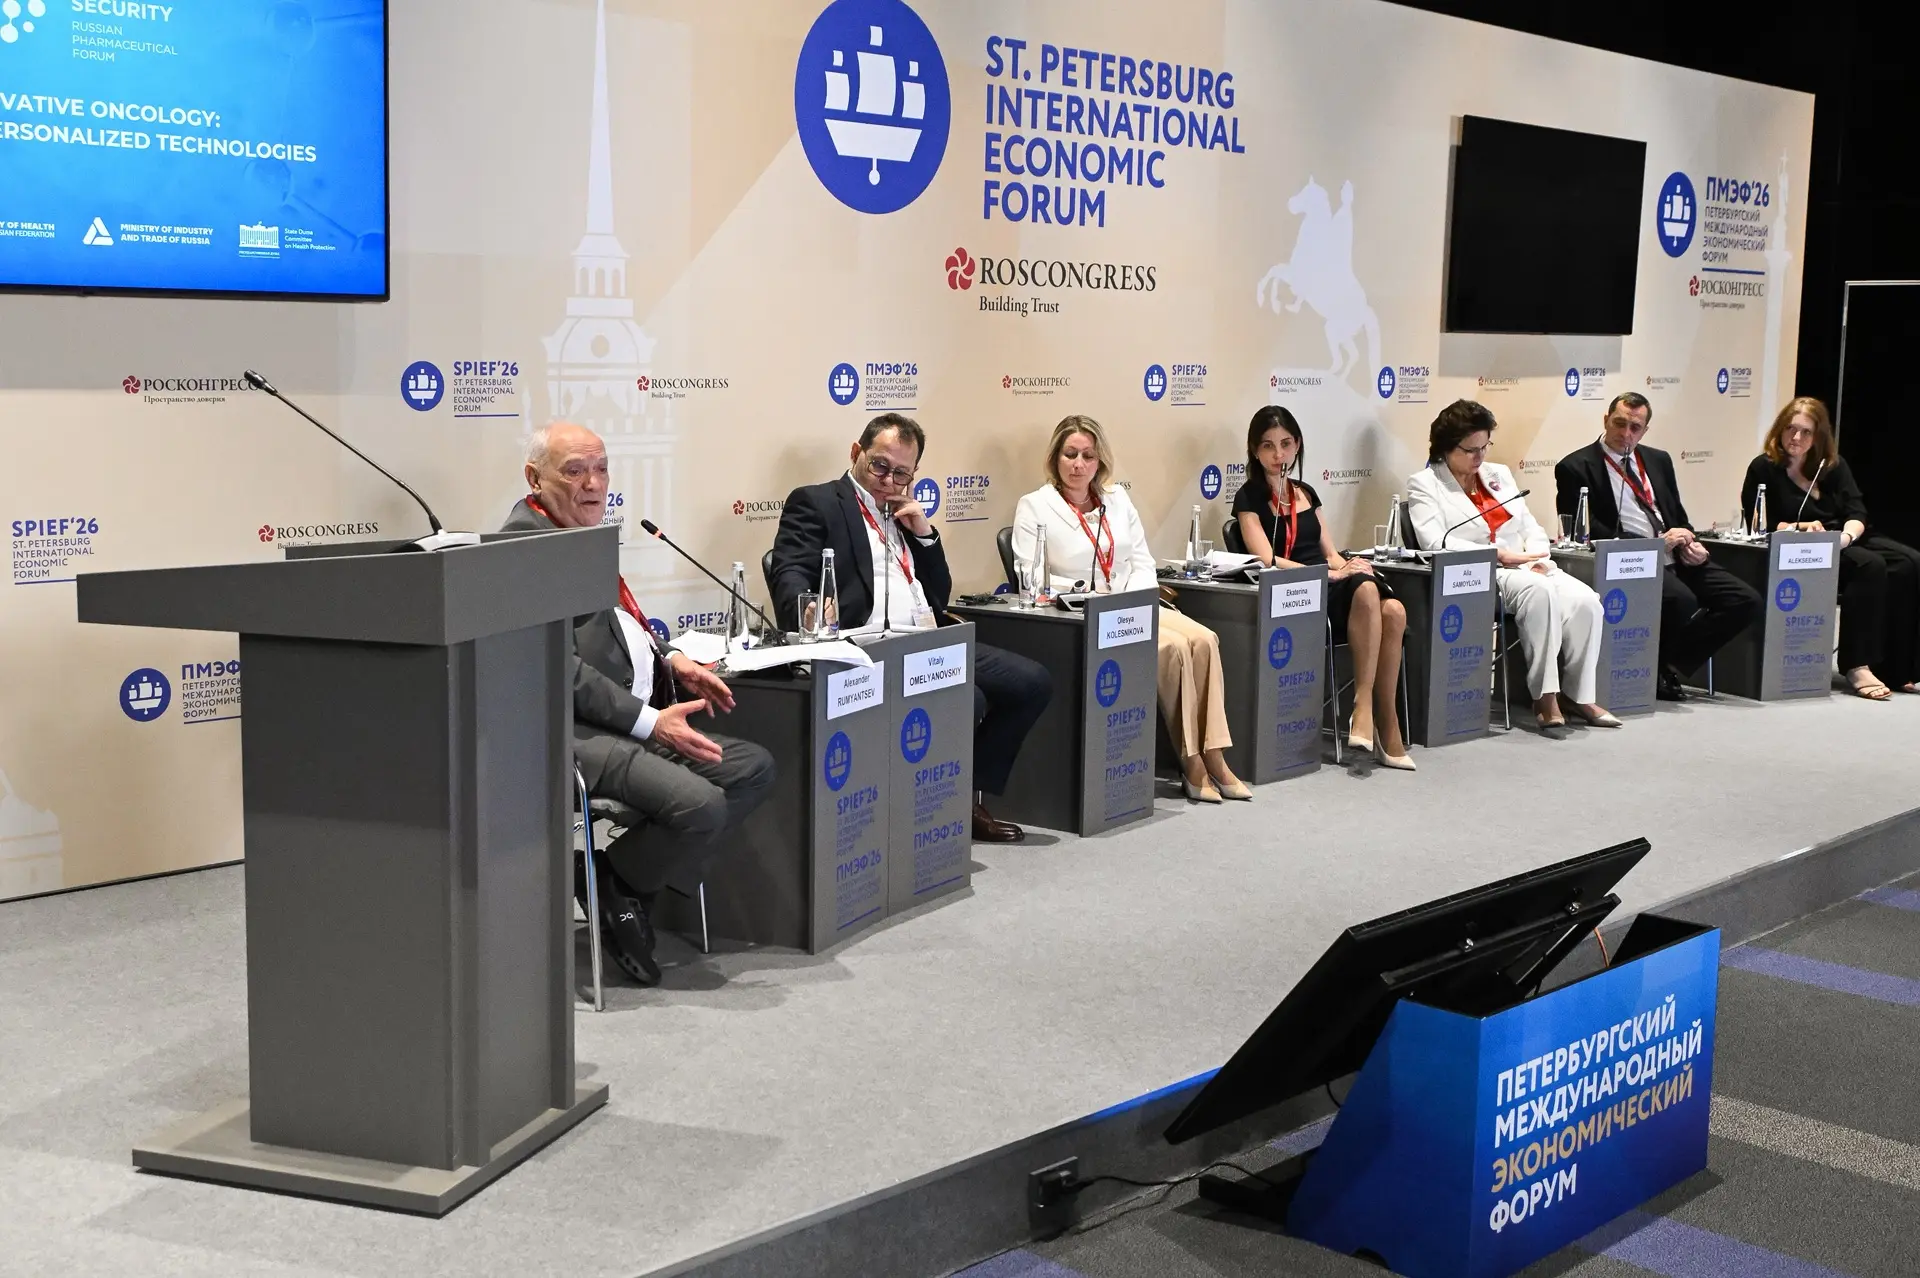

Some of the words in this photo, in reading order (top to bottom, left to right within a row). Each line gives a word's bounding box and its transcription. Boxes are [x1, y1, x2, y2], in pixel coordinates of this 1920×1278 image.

[72, 0, 173, 22] SECURITY
[72, 20, 122, 36] RUSSIAN
[72, 34, 178, 55] PHARMACEUTICAL
[72, 48, 115, 62] FORUM
[985, 36, 1030, 80] ST.
[1040, 44, 1235, 108] PETERSBURG
[90, 100, 221, 128] ONCOLOGY:
[985, 84, 1246, 154] INTERNATIONAL
[0, 121, 150, 150] RSONALIZED
[156, 133, 317, 162] TECHNOLOGIES
[984, 132, 1166, 188] ECONOMIC
[1706, 177, 1770, 207] ПМЭФ'26
[983, 180, 1106, 228] FORUM
[1704, 206, 1760, 221] ПЕТЕРБУРГСКИЙ
[21, 222, 55, 230] HEALTH
[121, 224, 160, 232] MINISTRY
[174, 227, 213, 236] INDUSTRY
[1704, 221, 1768, 237] МЕЖДУНАРОДНЫЙ
[1703, 236, 1765, 251] ЭКОНОМИЧЕСКИЙ
[1702, 251, 1728, 263] ФОРУМ
[979, 257, 1158, 292] ROSCONGRESS
[1700, 280, 1764, 297] РОСКОНГРЕСС
[979, 296, 1028, 317] Building
[1030, 298, 1060, 314] Trust
[454, 361, 519, 376] SPIEF'26
[866, 363, 918, 376] ПМЭФ'26
[1172, 364, 1207, 375] SPIEF'26
[651, 378, 729, 389] ROSCONGRESS
[1012, 377, 1070, 386] РОСКОНГРЕСС
[144, 396, 195, 404] Пространство
[1330, 469, 1372, 478] РОСКОНГРЕСС
[947, 475, 989, 488] SPIEF'26
[12, 517, 99, 537] SPIEF'26
[277, 522, 378, 539] ROSCONGRESS
[29, 538, 90, 548] PETERSBURG
[13, 547, 94, 559] INTERNATIONAL
[14, 558, 68, 569] ECONOMIC
[14, 570, 50, 578] FORUM
[1452, 580, 1481, 588] SAMOYLOVA
[1286, 588, 1308, 597] Ekaterina
[1282, 599, 1311, 609] YAKOVLEVA
[1117, 616, 1134, 625] Olesya
[1106, 627, 1144, 639] KOLESNIKOVA
[928, 656, 944, 666] Vitaly
[182, 660, 240, 680] ПМЭФ
[910, 667, 962, 686] OMELYANOVSKIY
[182, 678, 240, 690] ПЕТЕРБУРГС
[843, 674, 870, 689] Alexander
[182, 687, 241, 700] МЕЖДУНАРО
[837, 688, 875, 707] RUMYANTSEV
[183, 697, 241, 709] ЭКОНОМИЧЕ
[183, 708, 216, 718] ФОРУМ
[915, 760, 961, 786] SPIEF'26
[1496, 993, 1676, 1106] ПЕТЕРБУРГСКИЙ
[1494, 1018, 1702, 1148] МЕЖДУНАРОДНЫЙ
[1491, 1062, 1693, 1193] ЭКОНОМИЧЕСКИЙ
[1490, 1163, 1578, 1233] ФОРУМ
